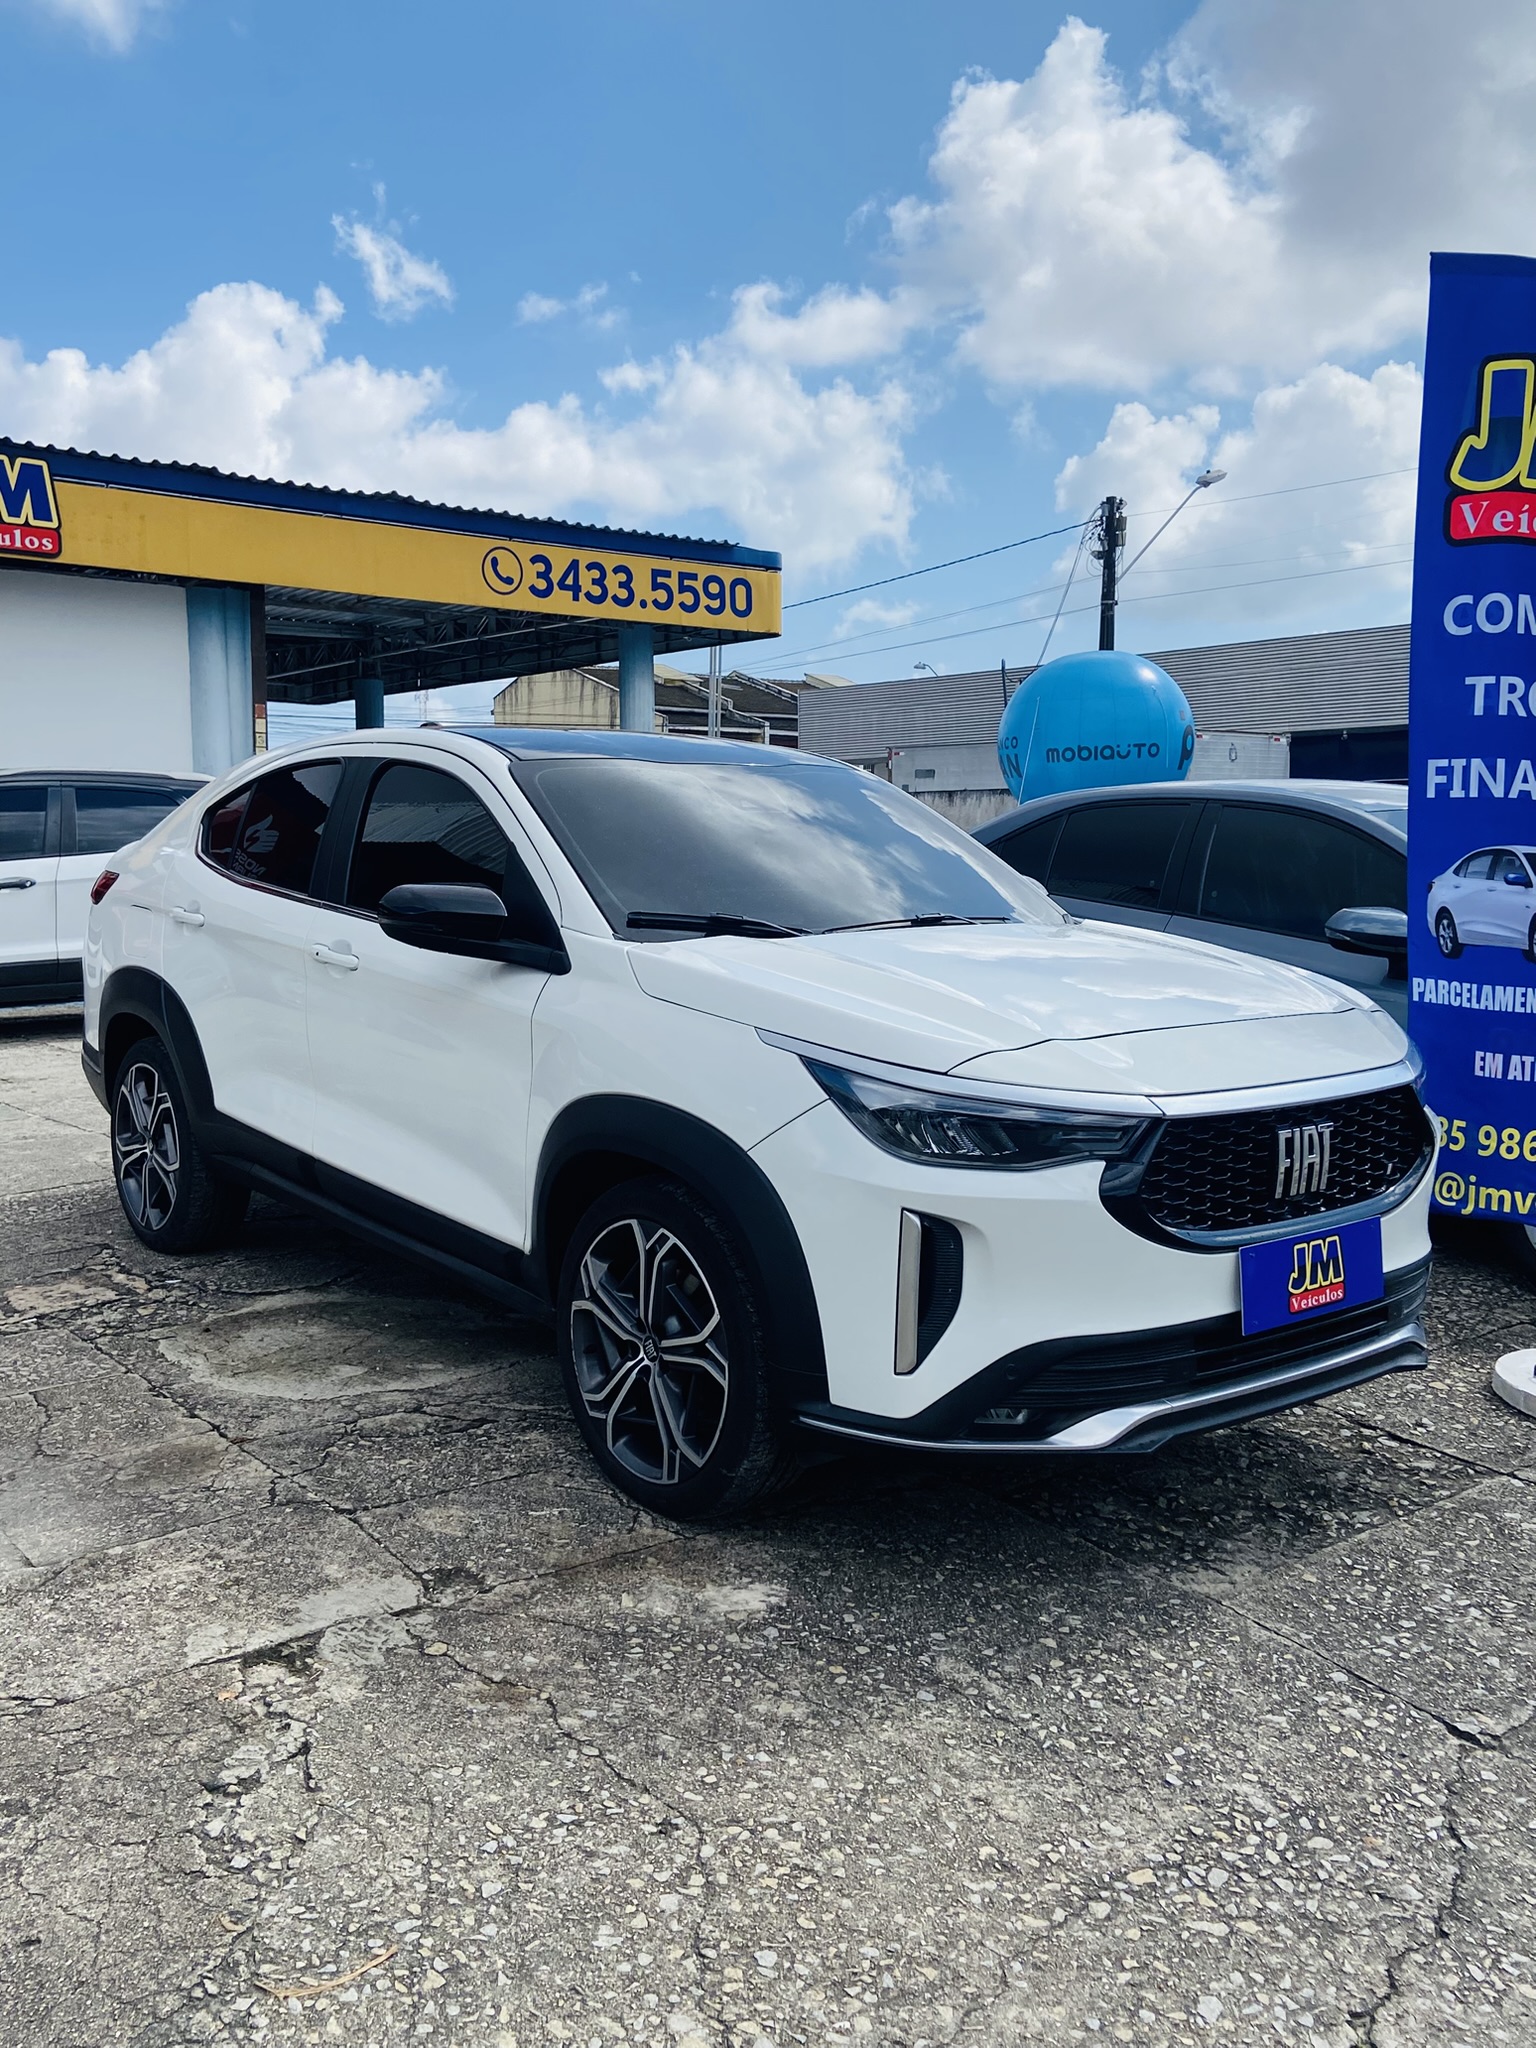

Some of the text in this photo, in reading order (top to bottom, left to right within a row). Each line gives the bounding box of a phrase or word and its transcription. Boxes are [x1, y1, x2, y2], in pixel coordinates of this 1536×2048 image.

[1450, 359, 1536, 492] J
[1460, 500, 1536, 535] Veí
[528, 553, 753, 618] 3433.5590
[1465, 675, 1536, 717] TR
[998, 736, 1019, 750] NCO
[1474, 1051, 1536, 1082] EM AT
[1275, 1122, 1334, 1199] FIAT
[1434, 1171, 1536, 1215] @jmv
[1288, 1235, 1344, 1294] JM
[1292, 1288, 1343, 1310] Veículos
